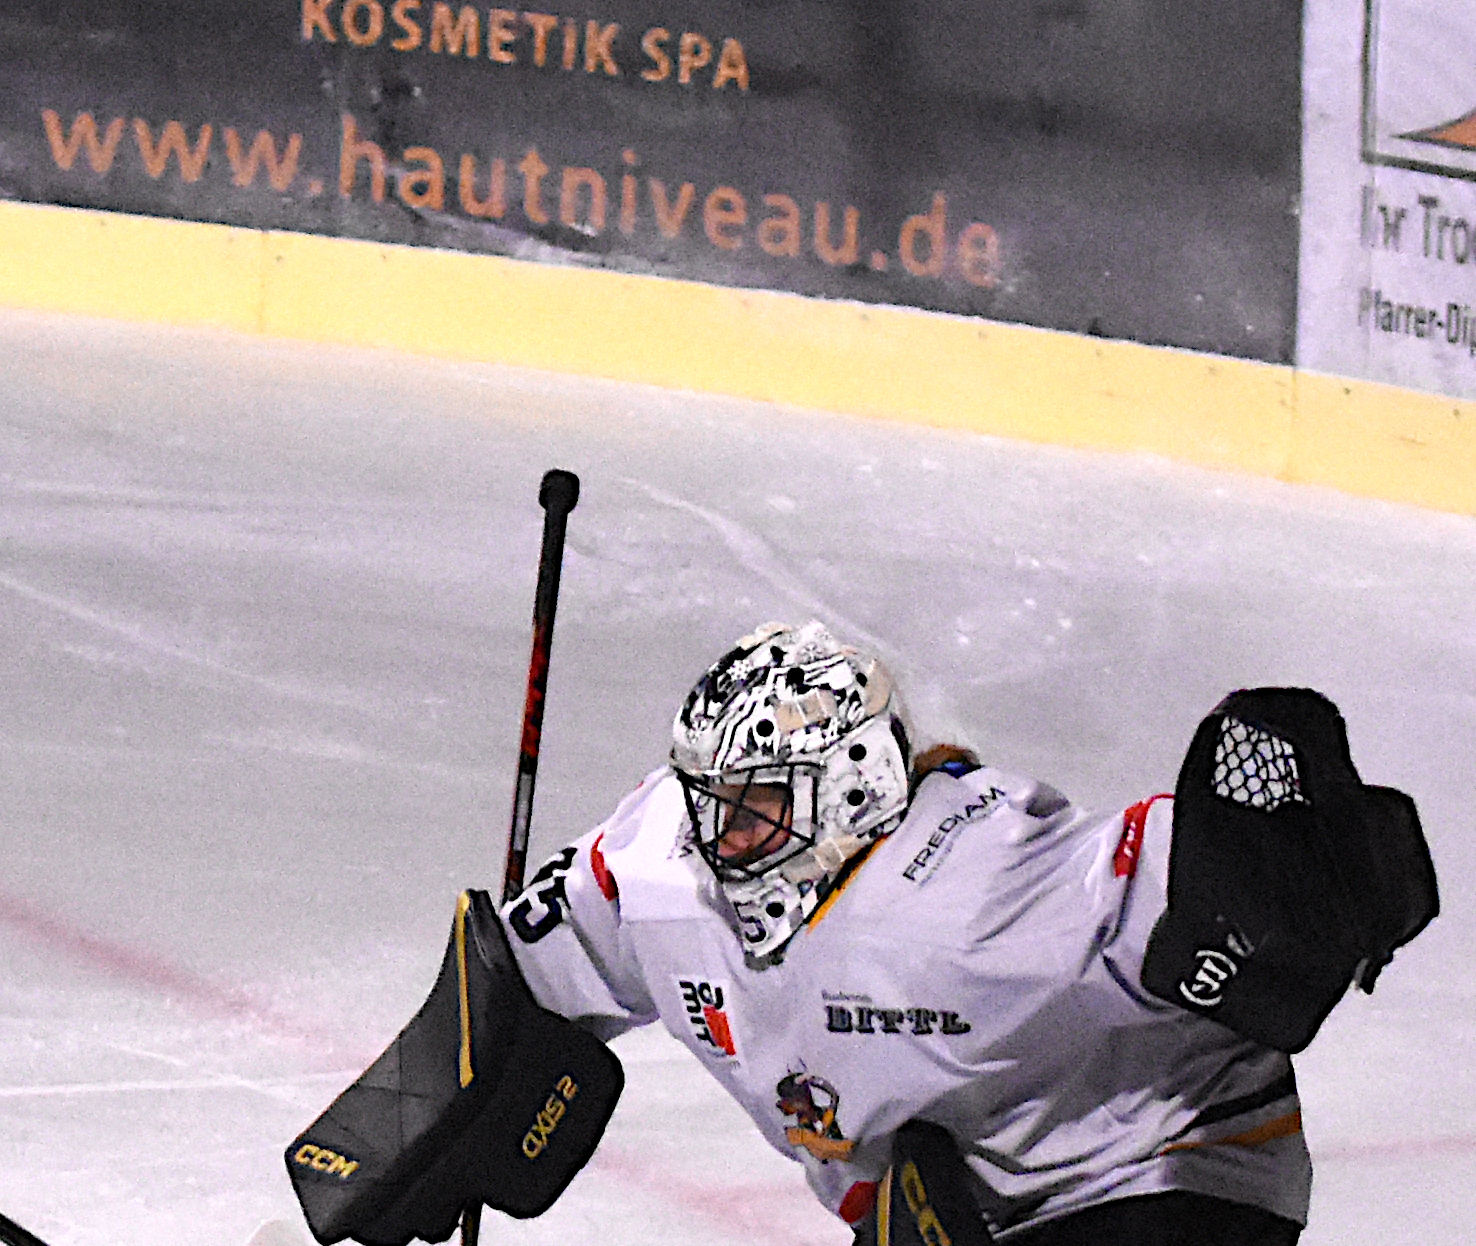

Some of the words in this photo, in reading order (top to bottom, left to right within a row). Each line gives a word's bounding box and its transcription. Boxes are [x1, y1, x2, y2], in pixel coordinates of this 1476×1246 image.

[301, 0, 618, 76] KOSMETIK
[641, 27, 750, 91] SPA
[41, 107, 1001, 288] www.hautniveau.de
[902, 786, 1006, 882] FREDIAM
[556, 1074, 579, 1101] 2
[294, 1144, 359, 1179] CCM
